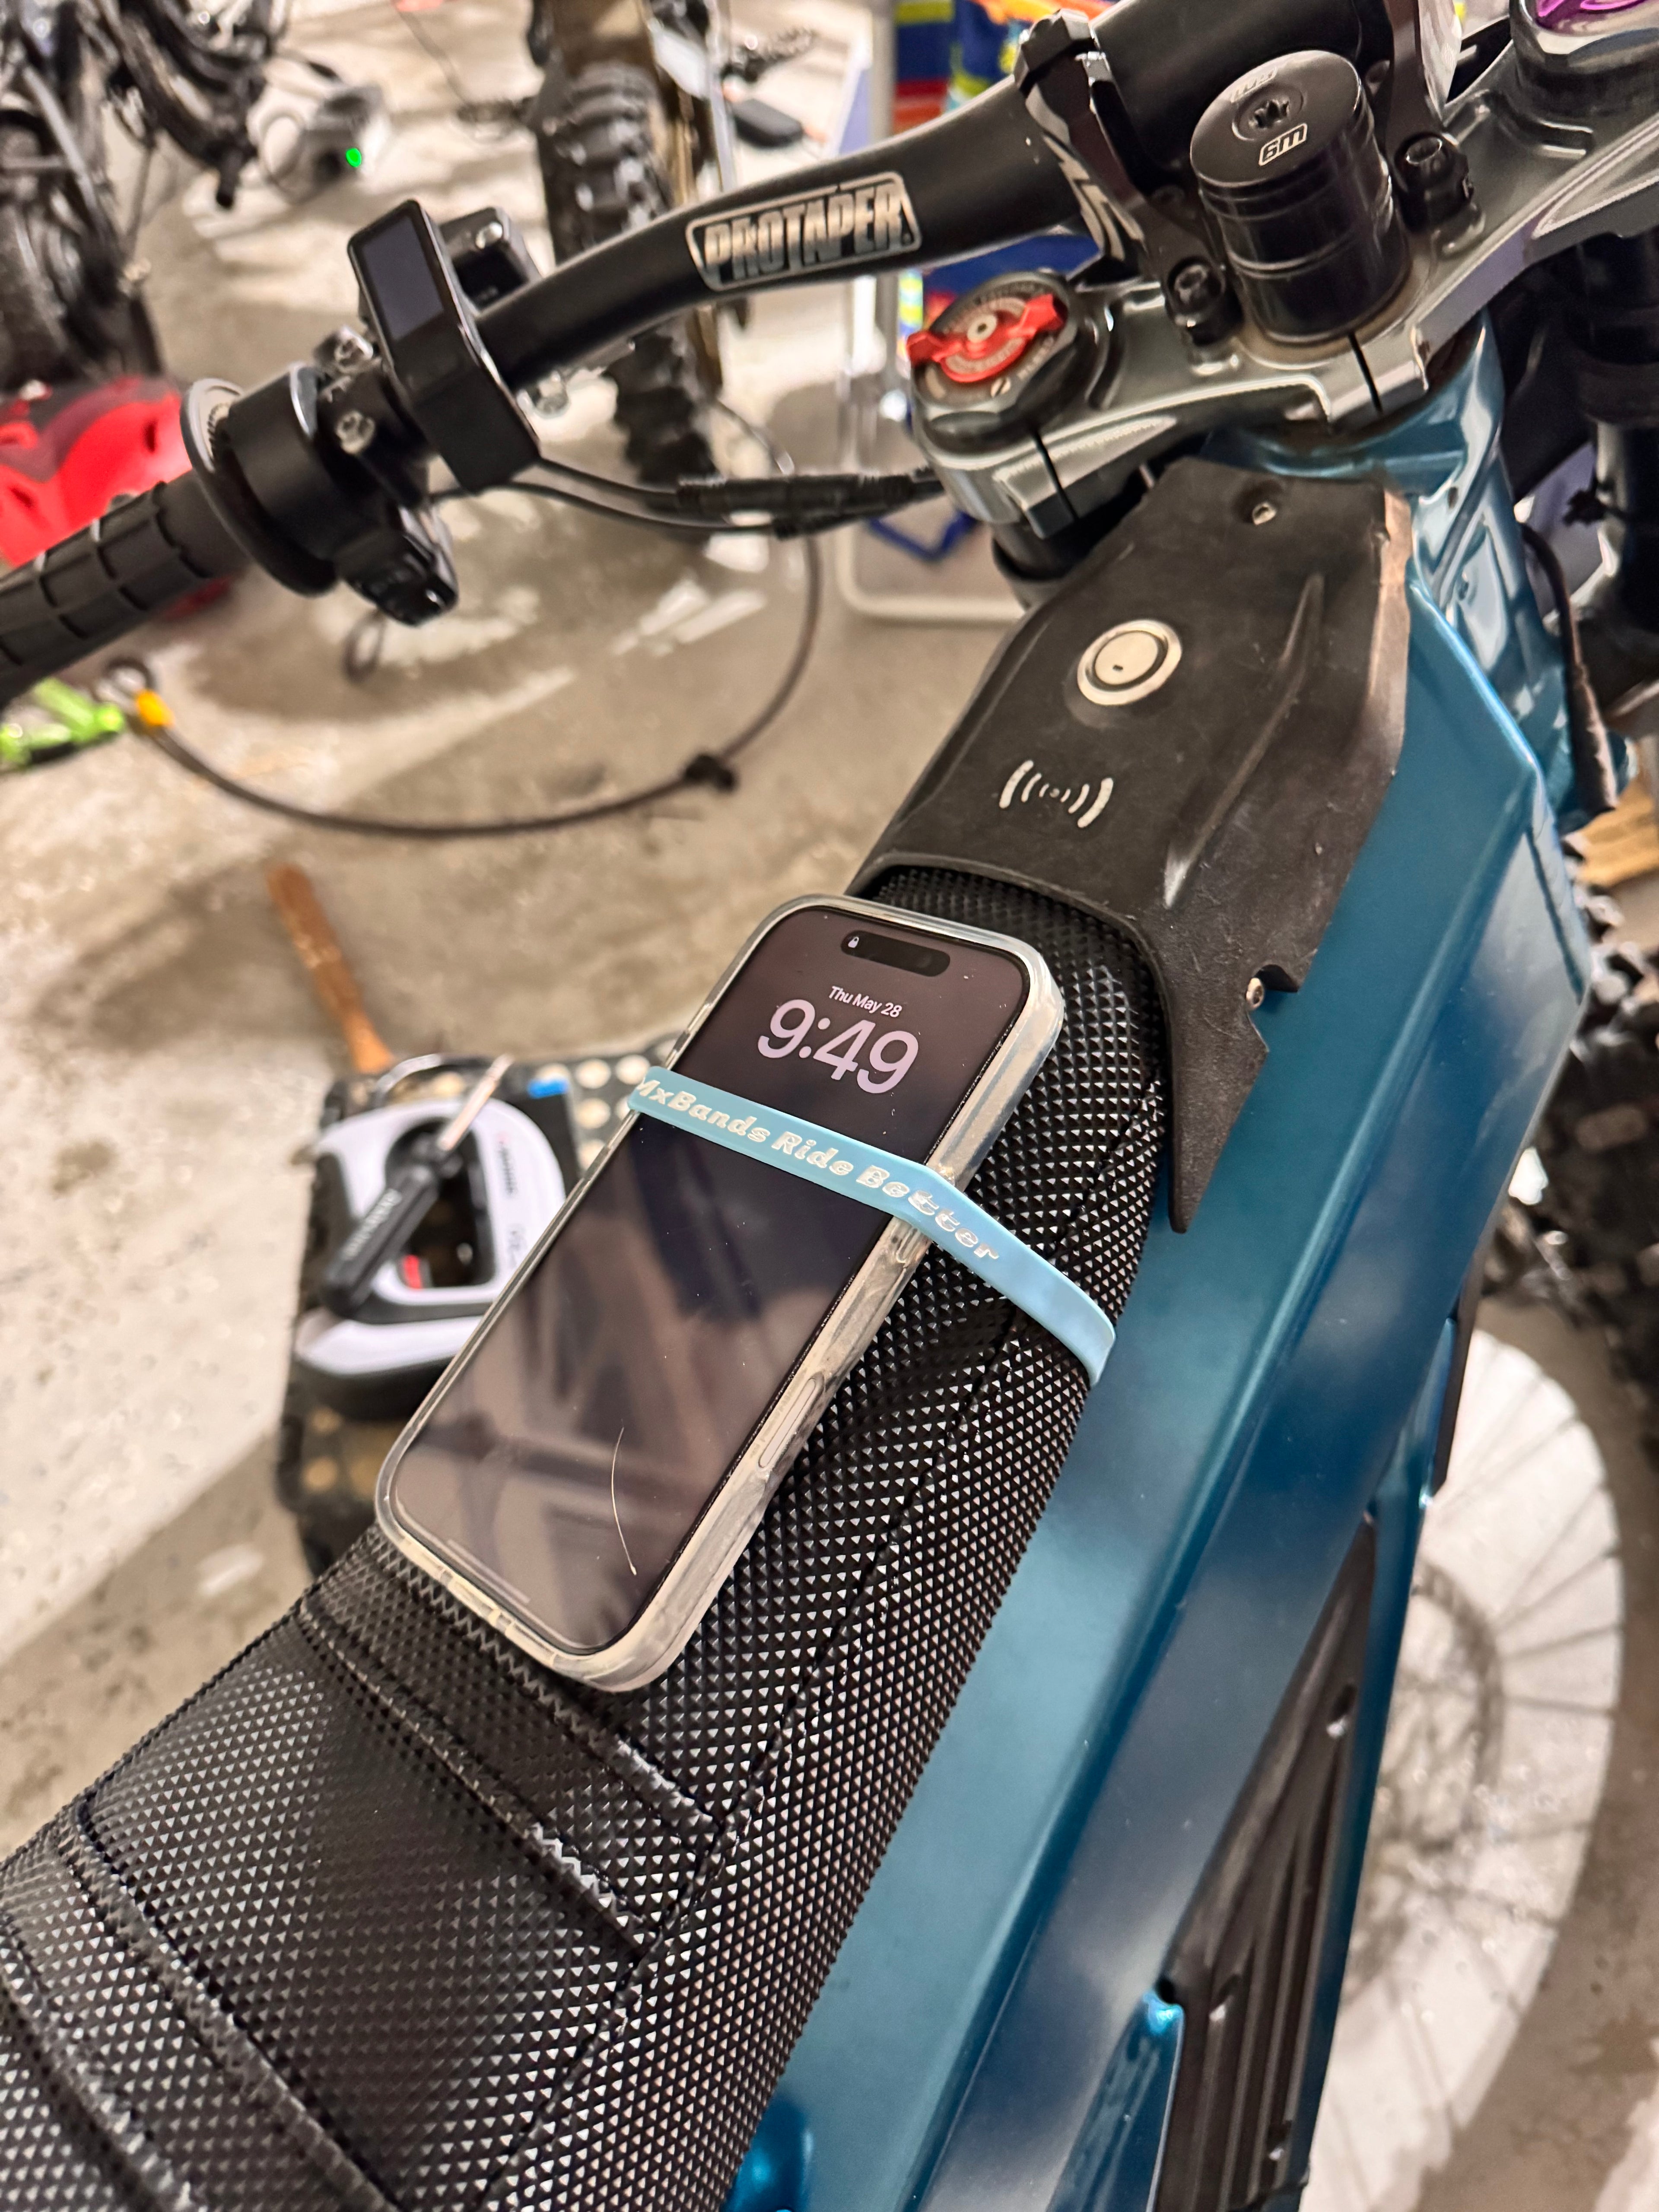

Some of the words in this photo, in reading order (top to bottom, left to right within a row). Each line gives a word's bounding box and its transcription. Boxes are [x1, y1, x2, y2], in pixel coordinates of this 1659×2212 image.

[704, 181, 903, 283] PROTAPER
[757, 998, 919, 1094] 9:49
[828, 985, 853, 1004] Thu
[852, 993, 883, 1014] May
[880, 1002, 903, 1018] 28
[771, 1131, 855, 1176] Ride
[856, 1164, 1000, 1260] Better
